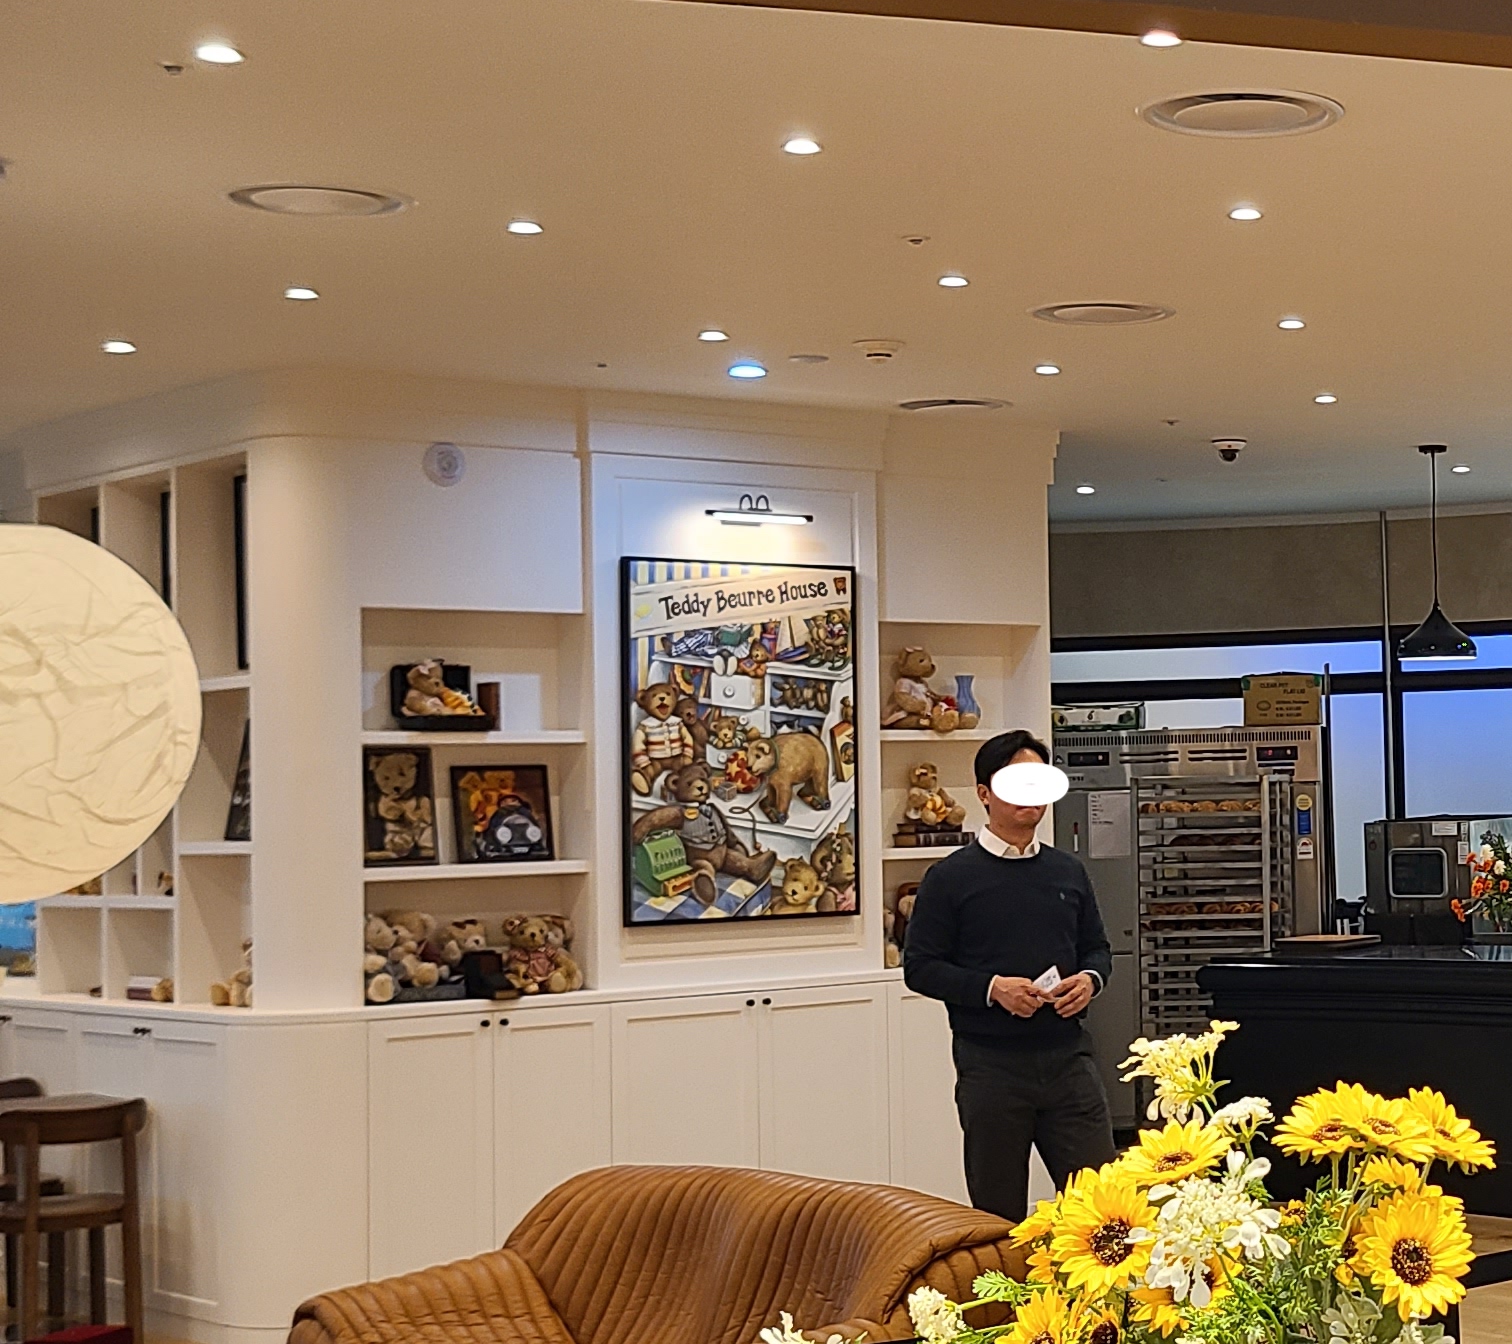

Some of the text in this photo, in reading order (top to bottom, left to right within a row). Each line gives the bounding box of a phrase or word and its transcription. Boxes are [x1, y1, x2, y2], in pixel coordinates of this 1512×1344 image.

[658, 581, 829, 620] Teddy Beurre House
